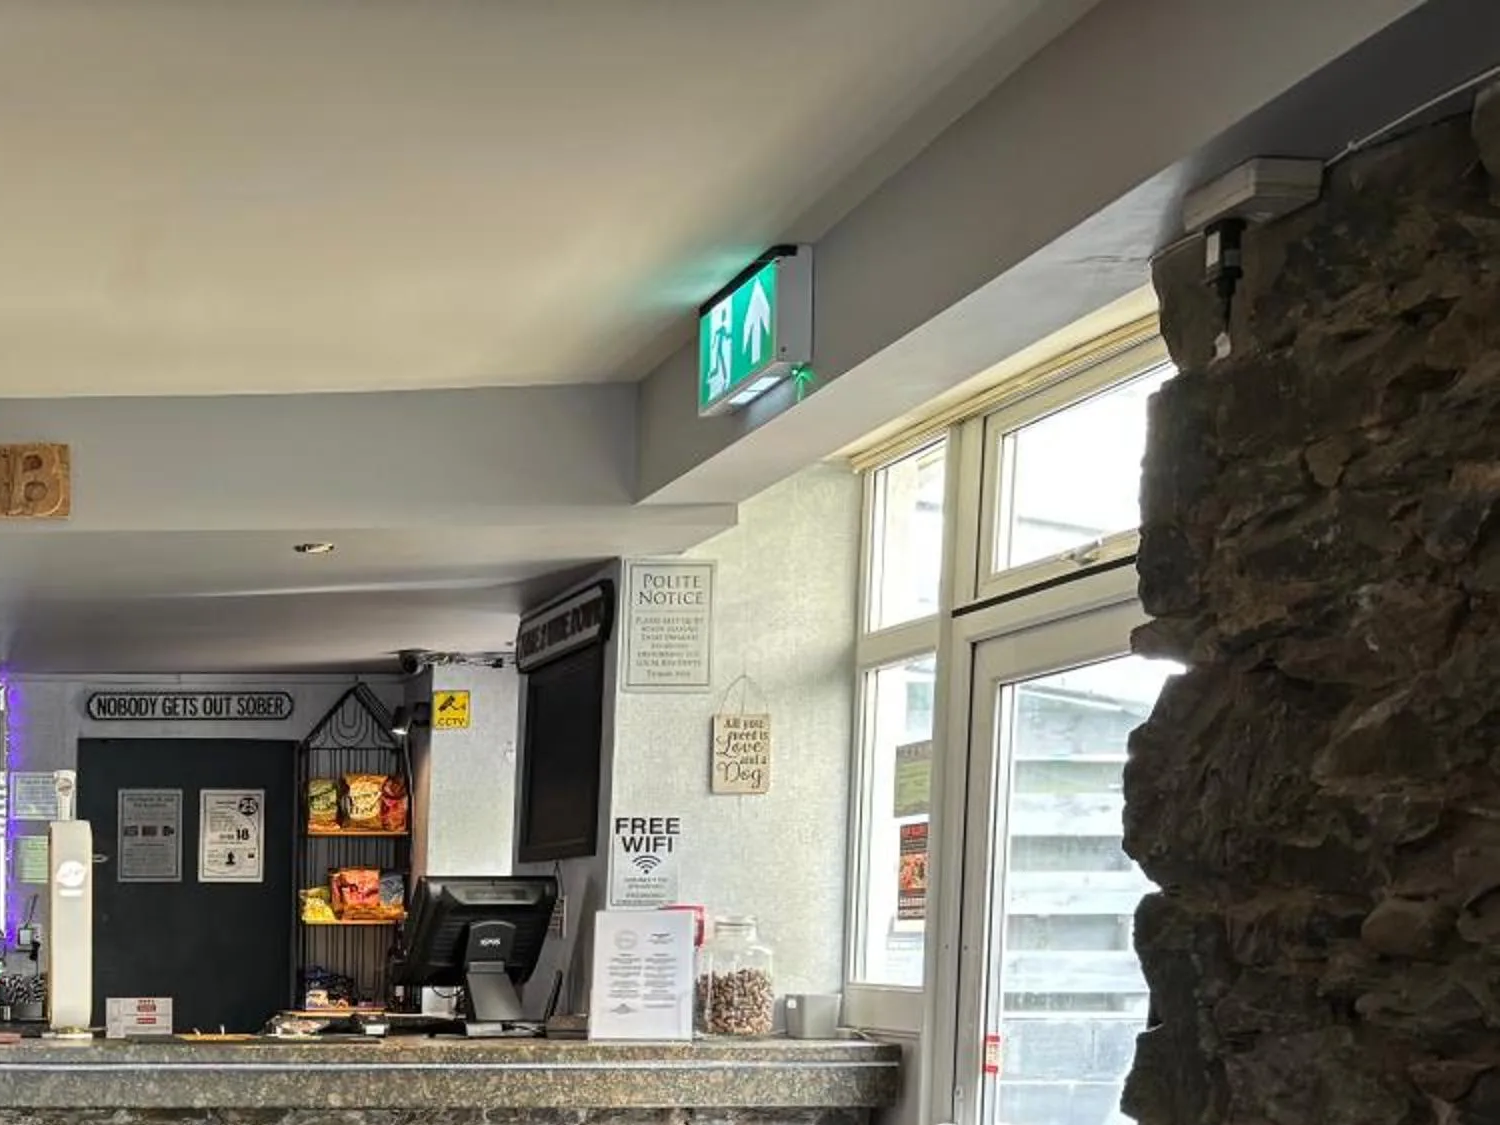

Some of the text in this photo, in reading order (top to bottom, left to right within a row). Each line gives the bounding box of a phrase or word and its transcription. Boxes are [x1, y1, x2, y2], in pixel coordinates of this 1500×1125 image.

[643, 573, 702, 589] POLITE
[637, 591, 704, 605] NOTICE
[97, 697, 284, 717] NOBODY GETS OUT SOBER
[437, 716, 466, 727] CCTV
[715, 731, 764, 758] Love
[716, 761, 762, 789] Dog
[615, 817, 681, 835] FREE
[621, 836, 673, 853] WIFI
